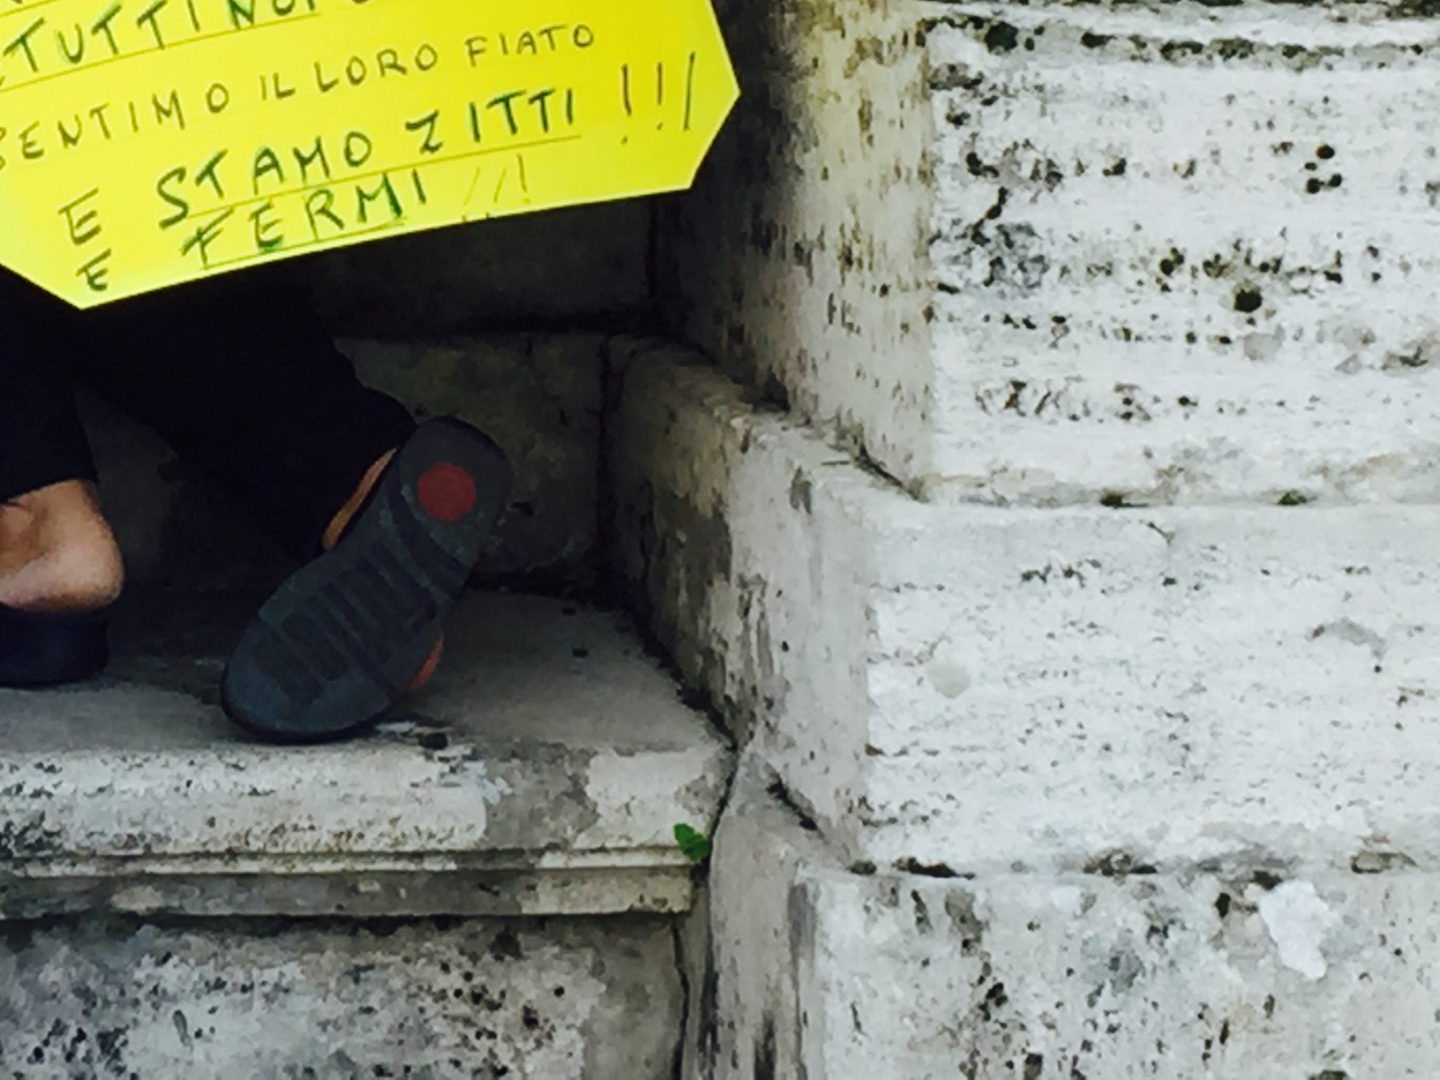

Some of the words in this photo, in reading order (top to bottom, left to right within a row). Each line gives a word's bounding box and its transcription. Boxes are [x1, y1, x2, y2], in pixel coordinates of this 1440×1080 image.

[259, 73, 296, 102] IL
[314, 42, 438, 94] LORO
[465, 22, 594, 68] FIATO
[58, 187, 103, 247] E
[156, 128, 373, 231] STAMO
[76, 246, 112, 294] E
